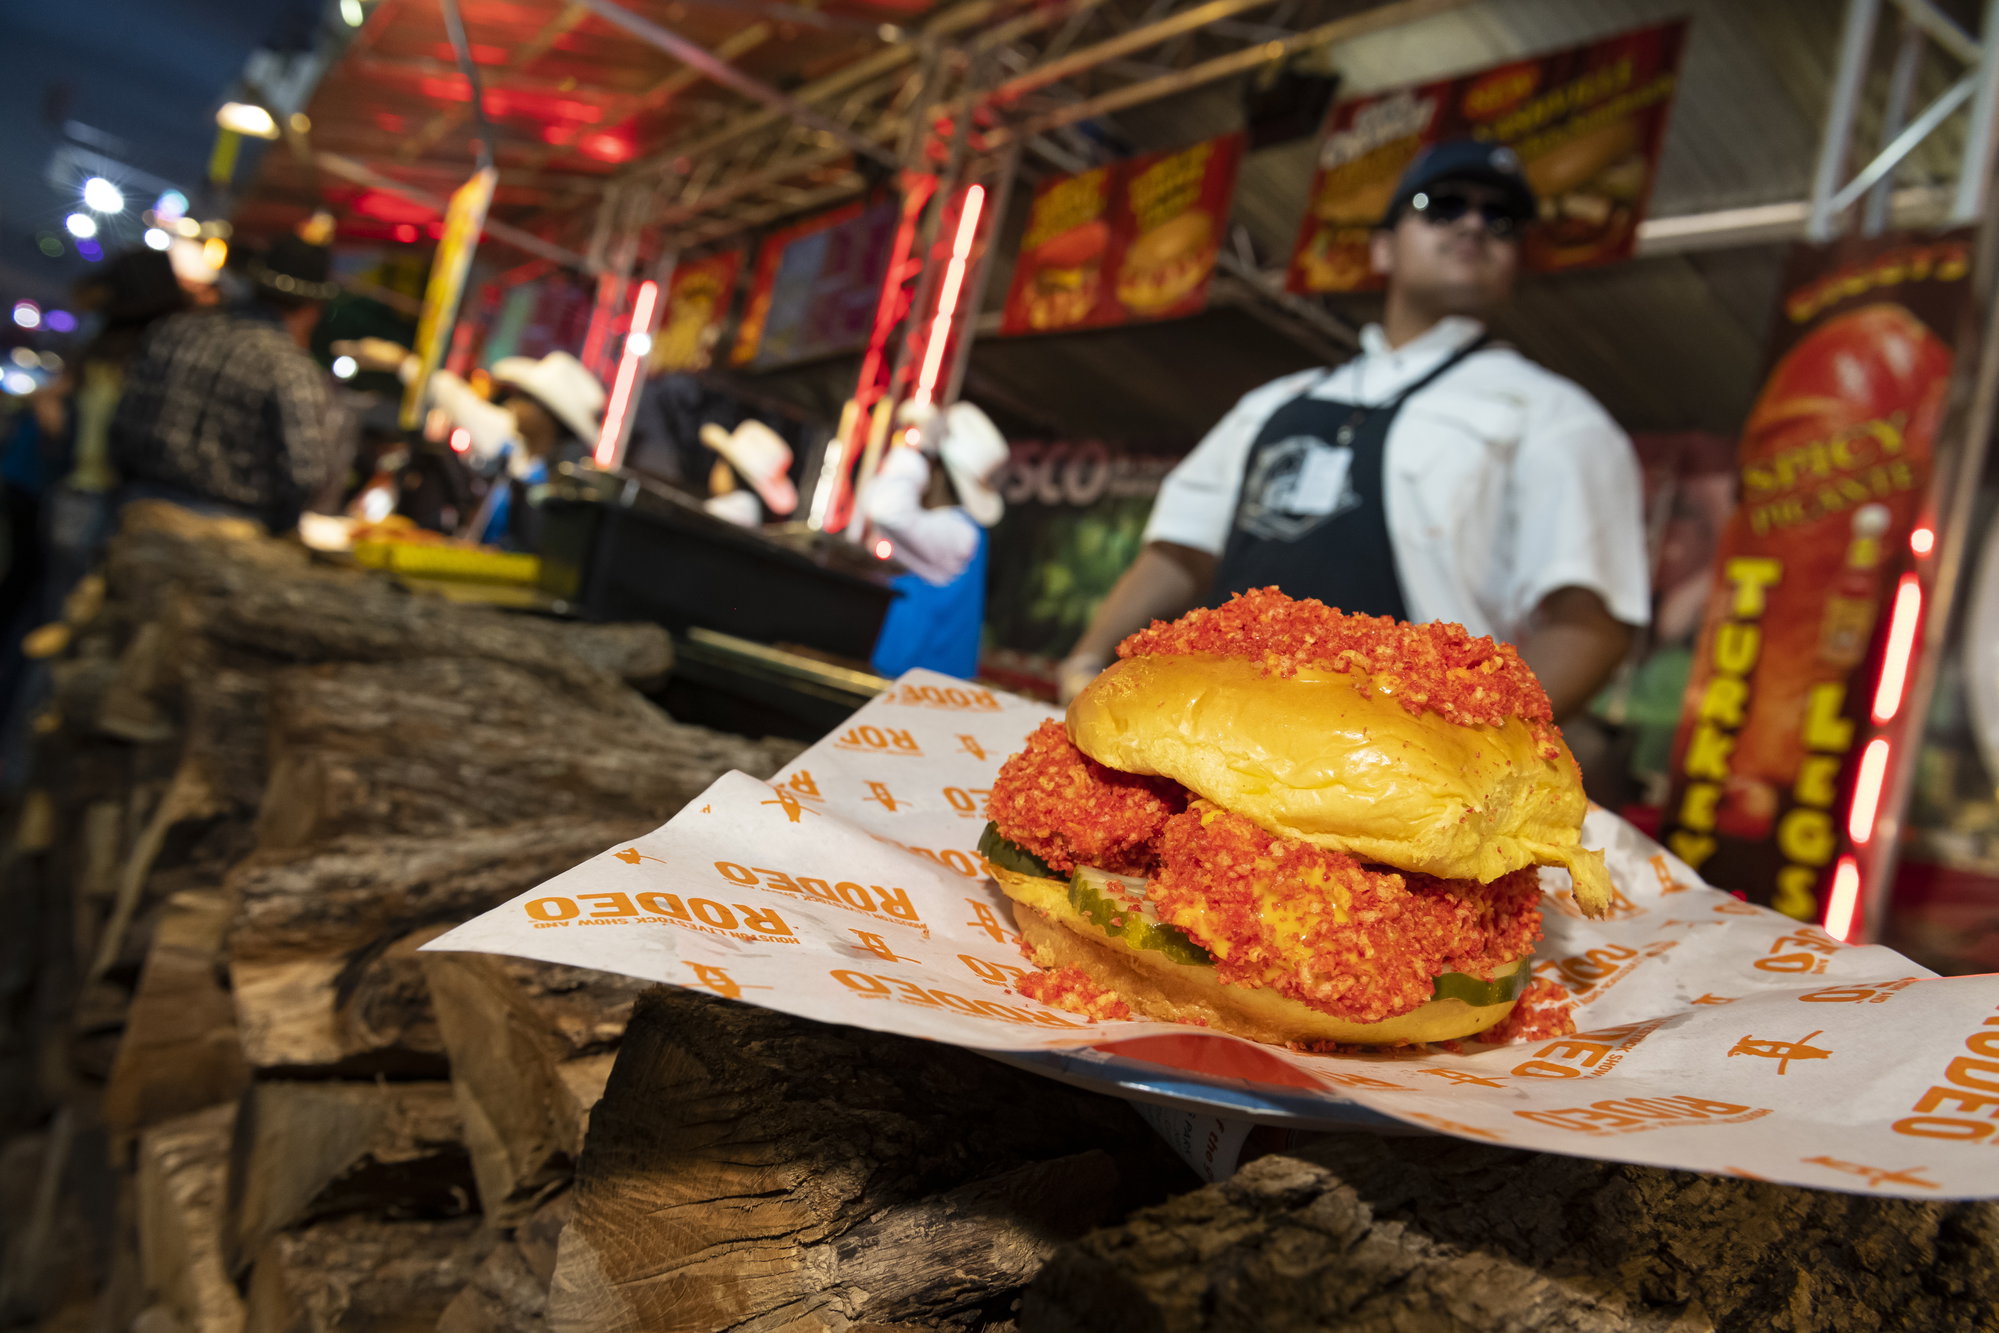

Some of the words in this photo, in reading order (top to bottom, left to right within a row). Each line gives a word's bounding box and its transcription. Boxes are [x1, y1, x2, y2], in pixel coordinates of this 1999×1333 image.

[1667, 556, 1782, 870] TURKEY
[1772, 682, 1855, 922] LEGS
[523, 891, 795, 937] RODEO
[714, 861, 920, 922] RODEO
[533, 920, 570, 930] AND
[577, 917, 630, 927] SHOW
[634, 917, 727, 938] LIVESTOCK
[829, 969, 1090, 1030] RODEO
[1512, 1095, 1751, 1132] RODEO
